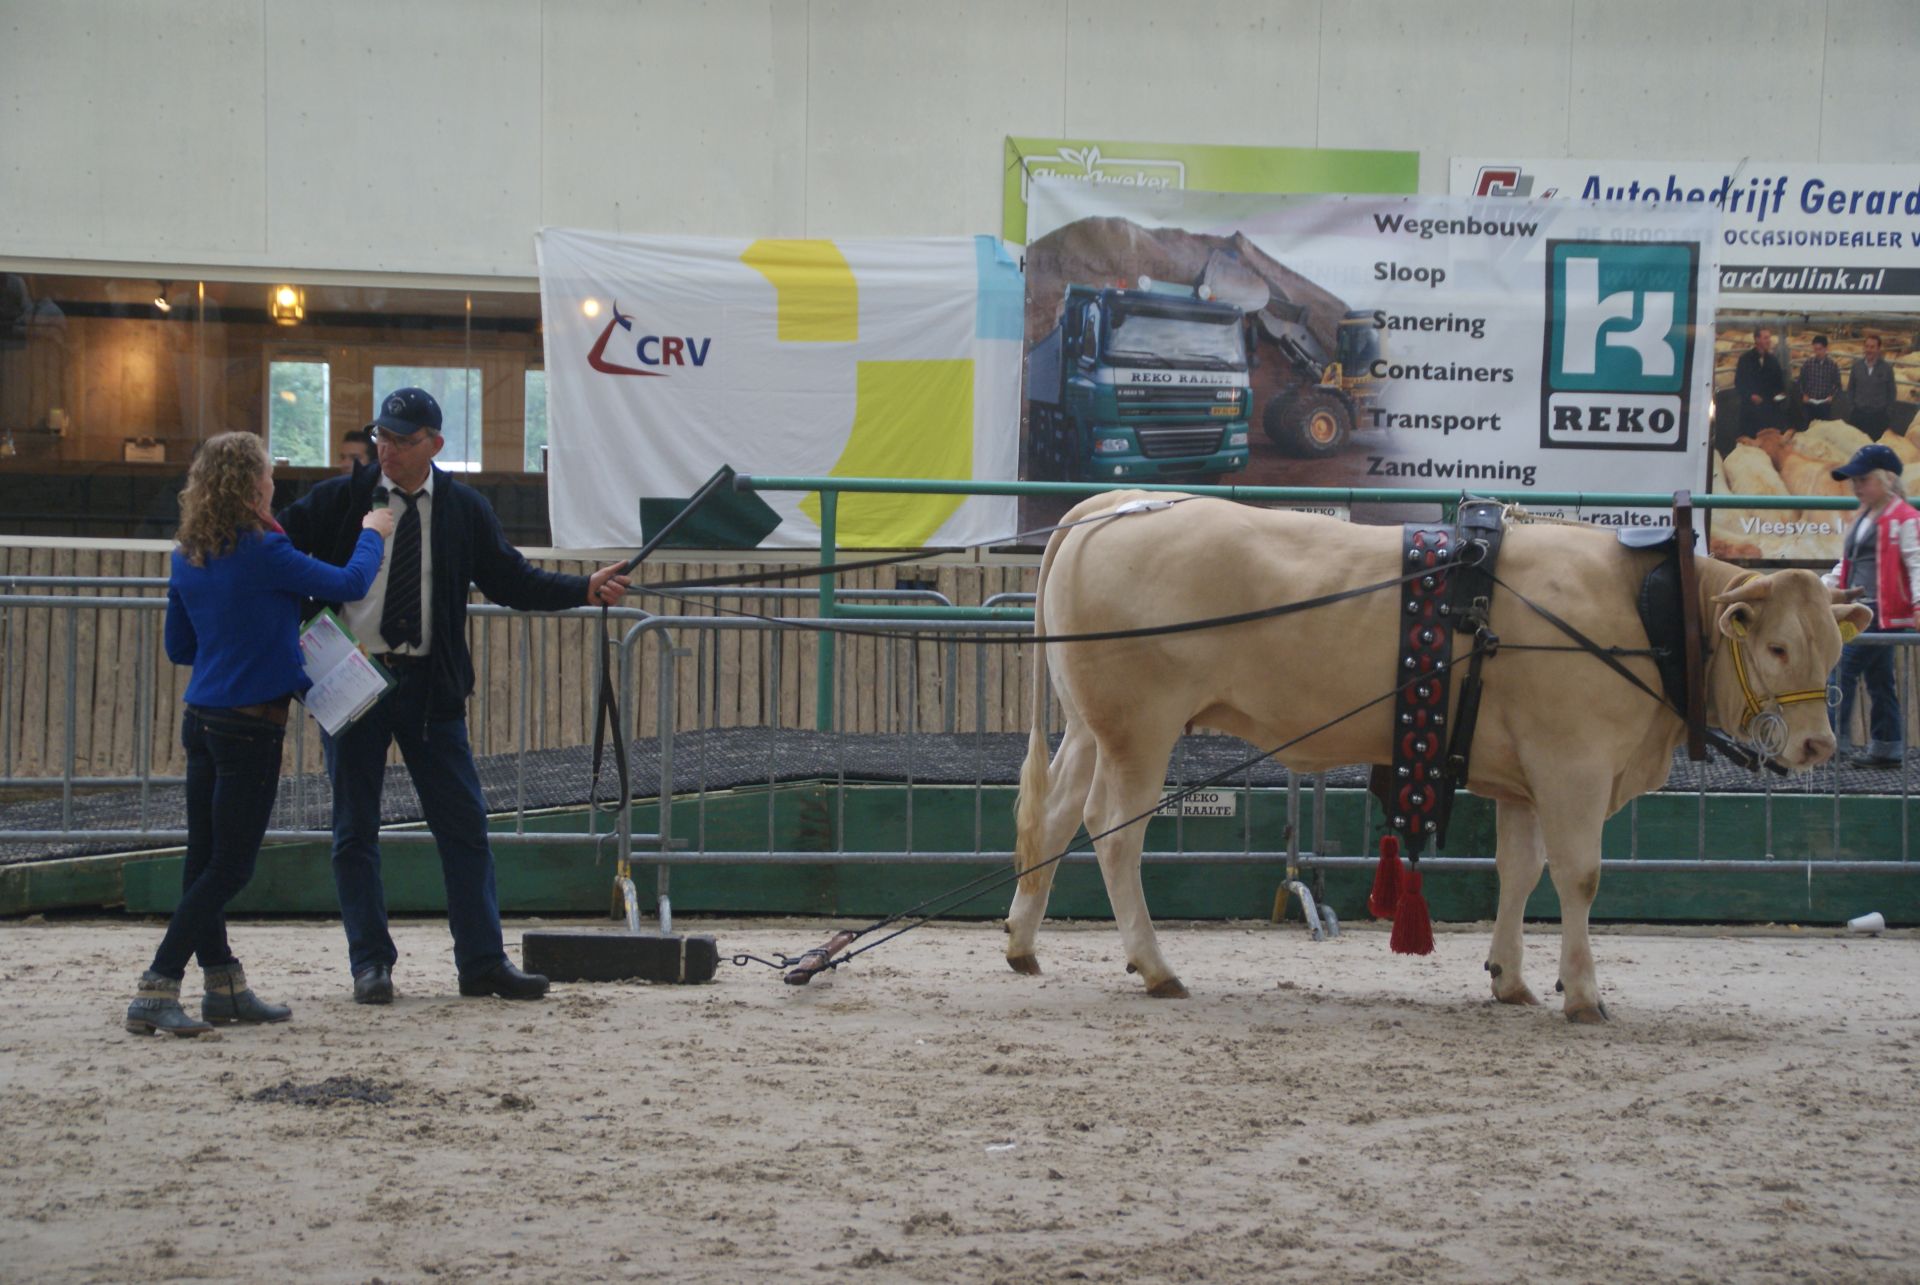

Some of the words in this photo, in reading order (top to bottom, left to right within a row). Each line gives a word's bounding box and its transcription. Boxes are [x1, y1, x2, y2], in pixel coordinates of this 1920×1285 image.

[1800, 178, 1920, 215] Gerard
[1374, 213, 1539, 240] Wegenbouw
[1724, 229, 1902, 249] OCCASIONDEALER
[1374, 261, 1446, 288] Sloop
[1373, 310, 1486, 339] Sanering
[636, 335, 711, 367] CRV
[1131, 372, 1172, 384] REKO
[1179, 374, 1232, 385] RAALTE
[1369, 359, 1514, 383] Containers
[1367, 408, 1501, 435] Transport
[1553, 405, 1675, 433] REKO
[1366, 456, 1537, 486] Zandwinning
[1579, 510, 1671, 527] -raalte.n
[1740, 517, 1831, 536] Vleesvee
[1184, 793, 1219, 803] REKO
[1184, 806, 1232, 815] RAALTE
